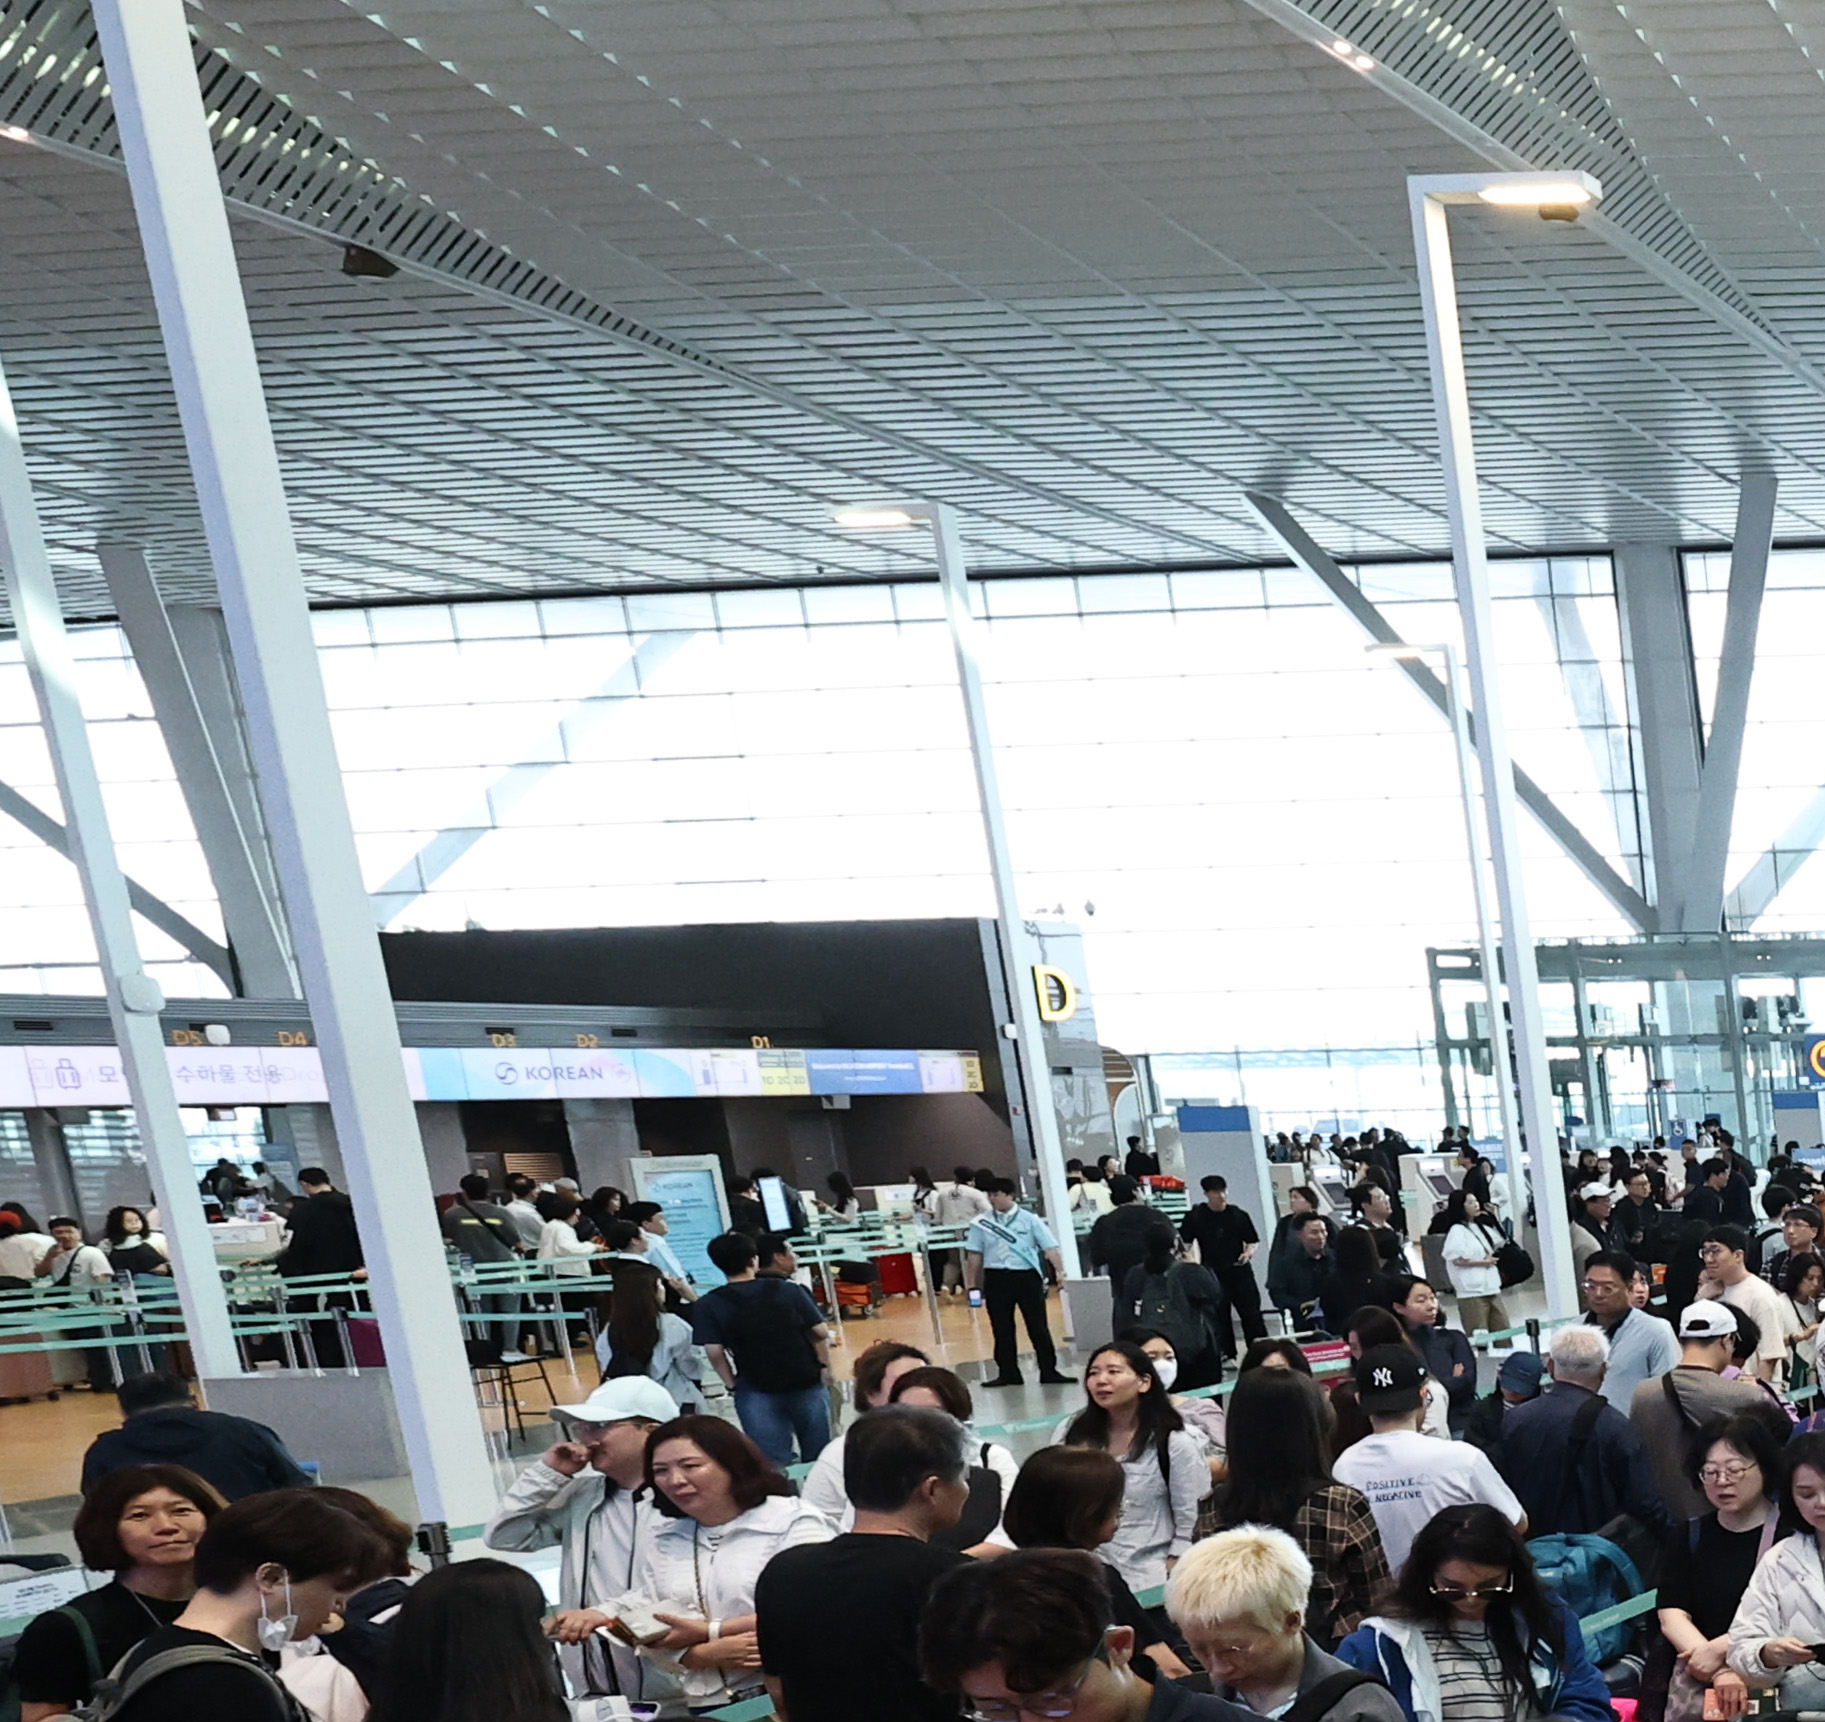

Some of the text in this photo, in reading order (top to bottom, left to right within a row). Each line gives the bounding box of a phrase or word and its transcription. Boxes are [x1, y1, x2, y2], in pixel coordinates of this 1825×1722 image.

[1031, 965, 1078, 1022] D
[171, 1029, 203, 1046] D5
[277, 1031, 308, 1047] D4
[752, 1036, 771, 1048] D1
[176, 1064, 236, 1084] 수하물
[525, 1066, 604, 1080] KOREAN
[1372, 1367, 1393, 1387] NY
[1366, 1477, 1415, 1491] POSITIVE
[1374, 1490, 1422, 1503] NEGATIVE
